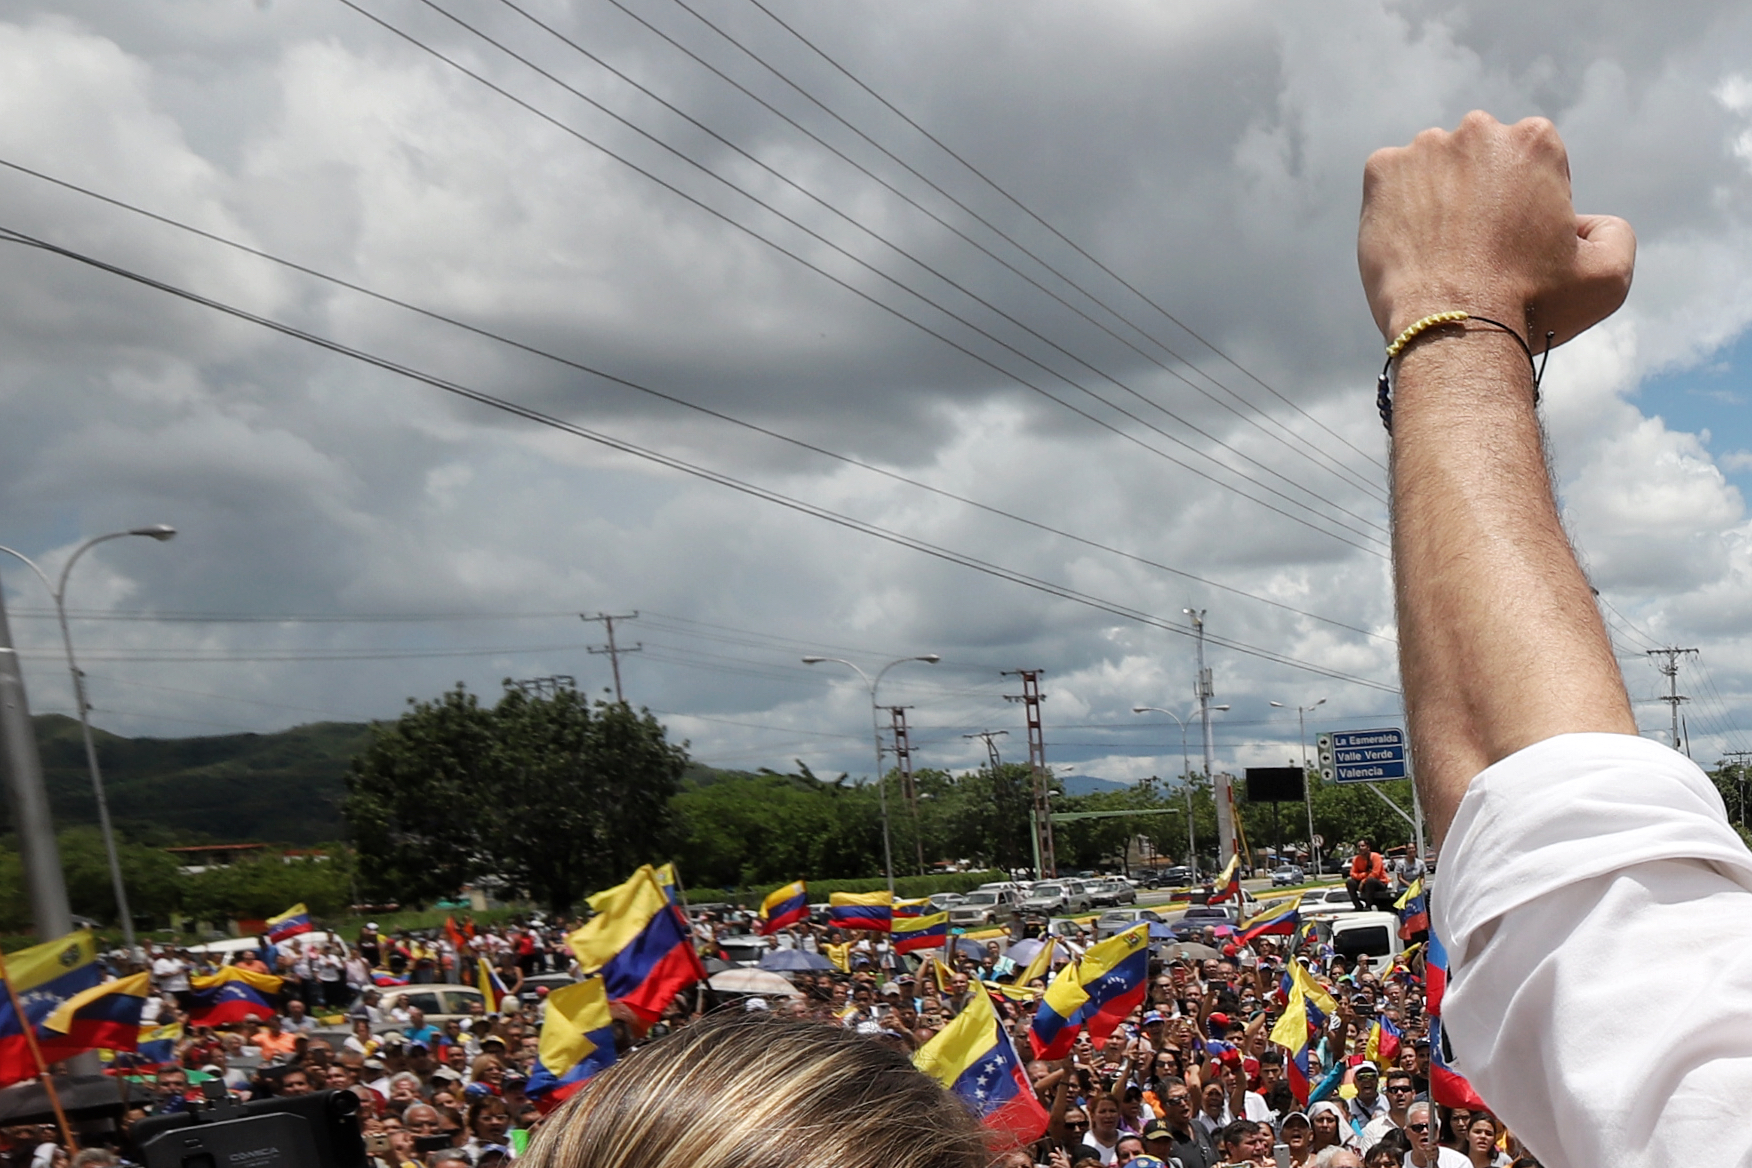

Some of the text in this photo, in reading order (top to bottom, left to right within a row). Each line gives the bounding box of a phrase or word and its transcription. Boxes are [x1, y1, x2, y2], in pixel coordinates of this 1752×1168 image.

[1335, 734, 1398, 746] La Esmeralda
[1337, 750, 1393, 762] Valle Verde
[1339, 766, 1383, 778] Valencia
